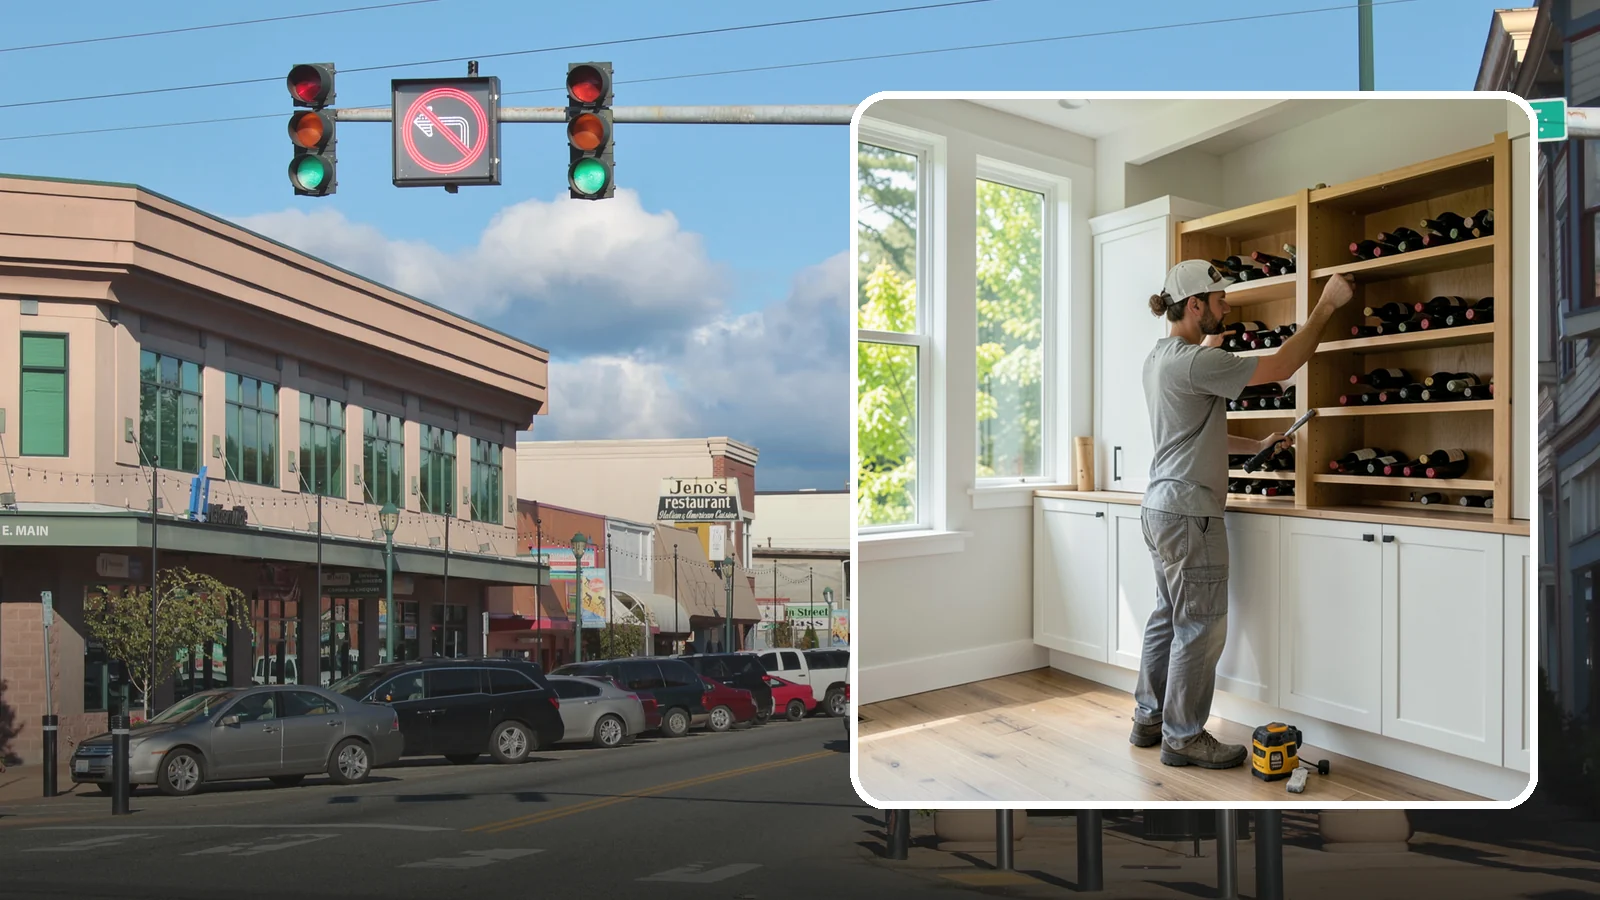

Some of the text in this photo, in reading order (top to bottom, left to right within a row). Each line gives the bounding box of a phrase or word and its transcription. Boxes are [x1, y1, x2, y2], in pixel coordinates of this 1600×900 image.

[669, 480, 728, 494] Jeno's
[665, 496, 731, 509] restaurant
[658, 510, 681, 519] Italian
[686, 509, 714, 519] American
[715, 509, 738, 519] Cuisine
[2, 525, 49, 536] E. MAIN
[797, 607, 829, 617] Street
